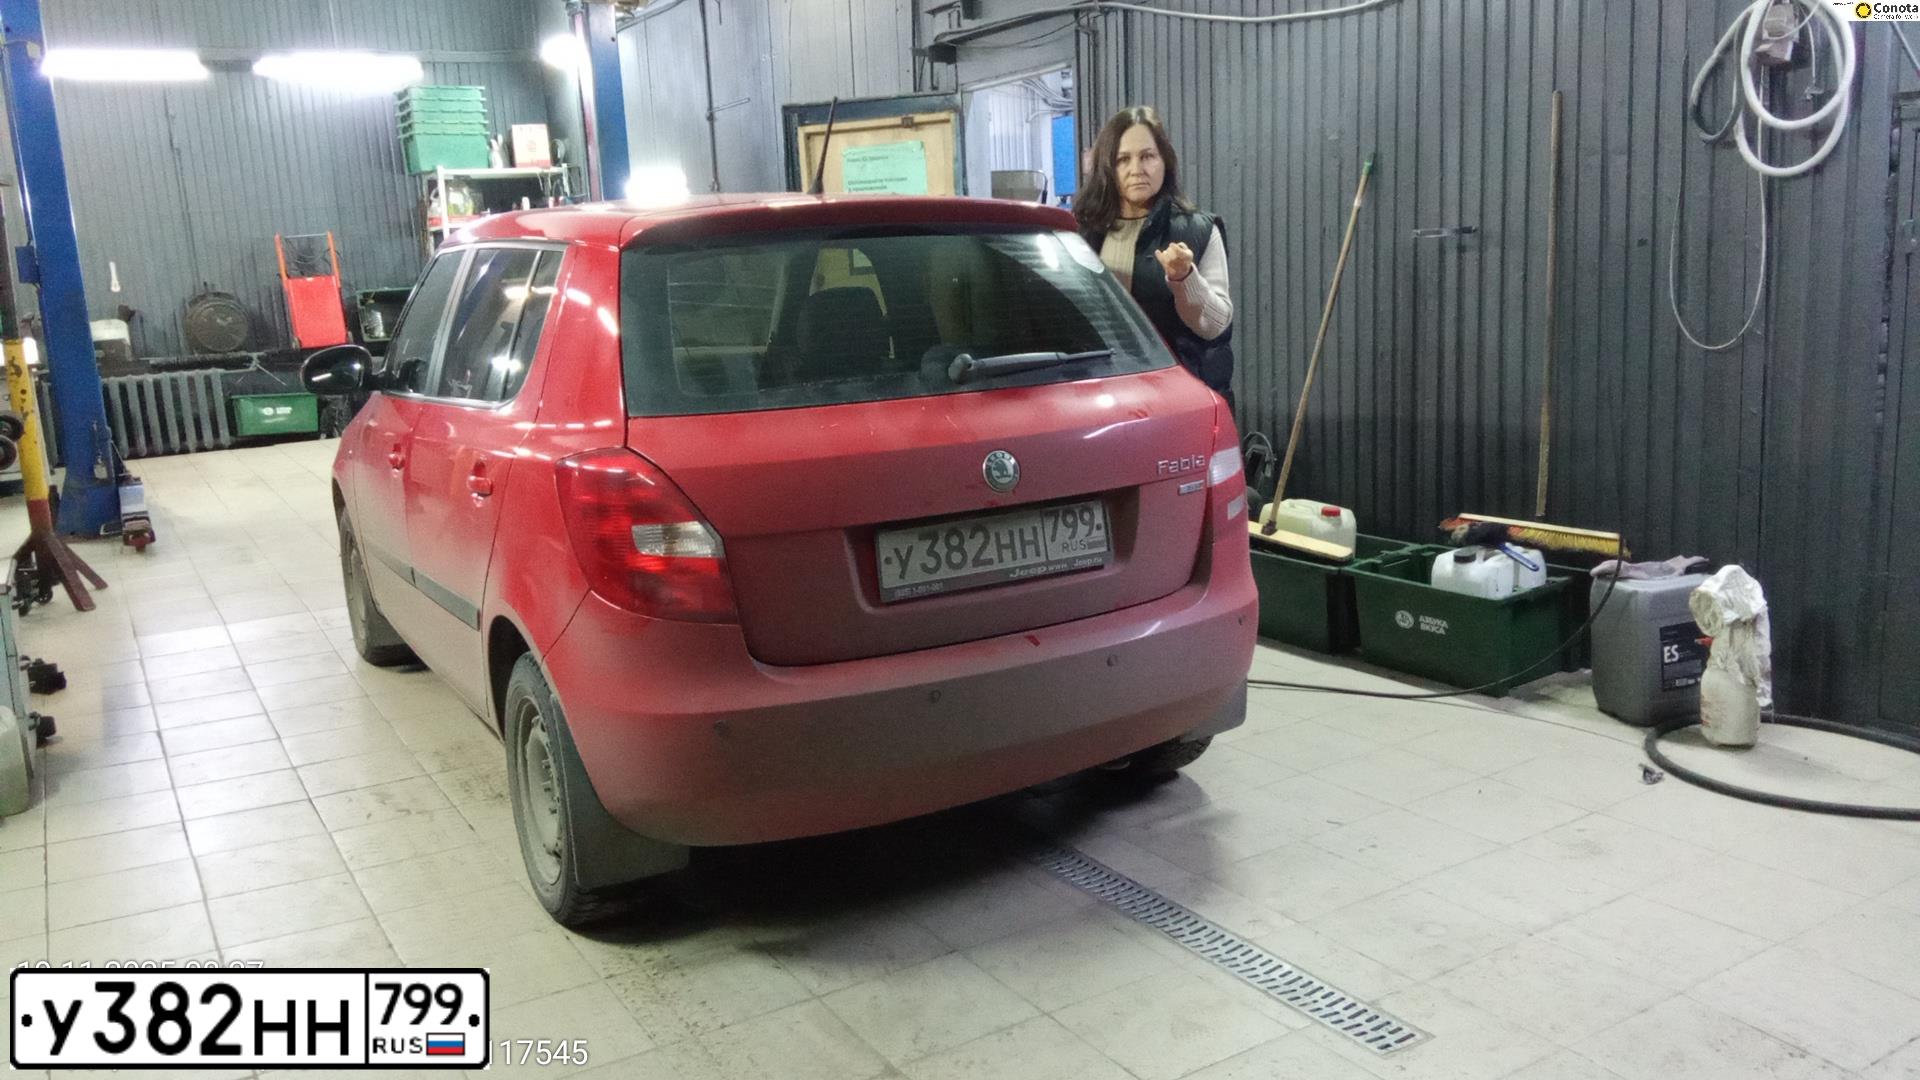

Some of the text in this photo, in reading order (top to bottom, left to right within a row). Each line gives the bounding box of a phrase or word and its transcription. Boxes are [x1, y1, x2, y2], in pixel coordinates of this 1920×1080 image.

[1157, 454, 1205, 475] Fabia
[1044, 507, 1096, 542] 799
[1062, 539, 1087, 552] RUS
[1664, 645, 1680, 663] ES
